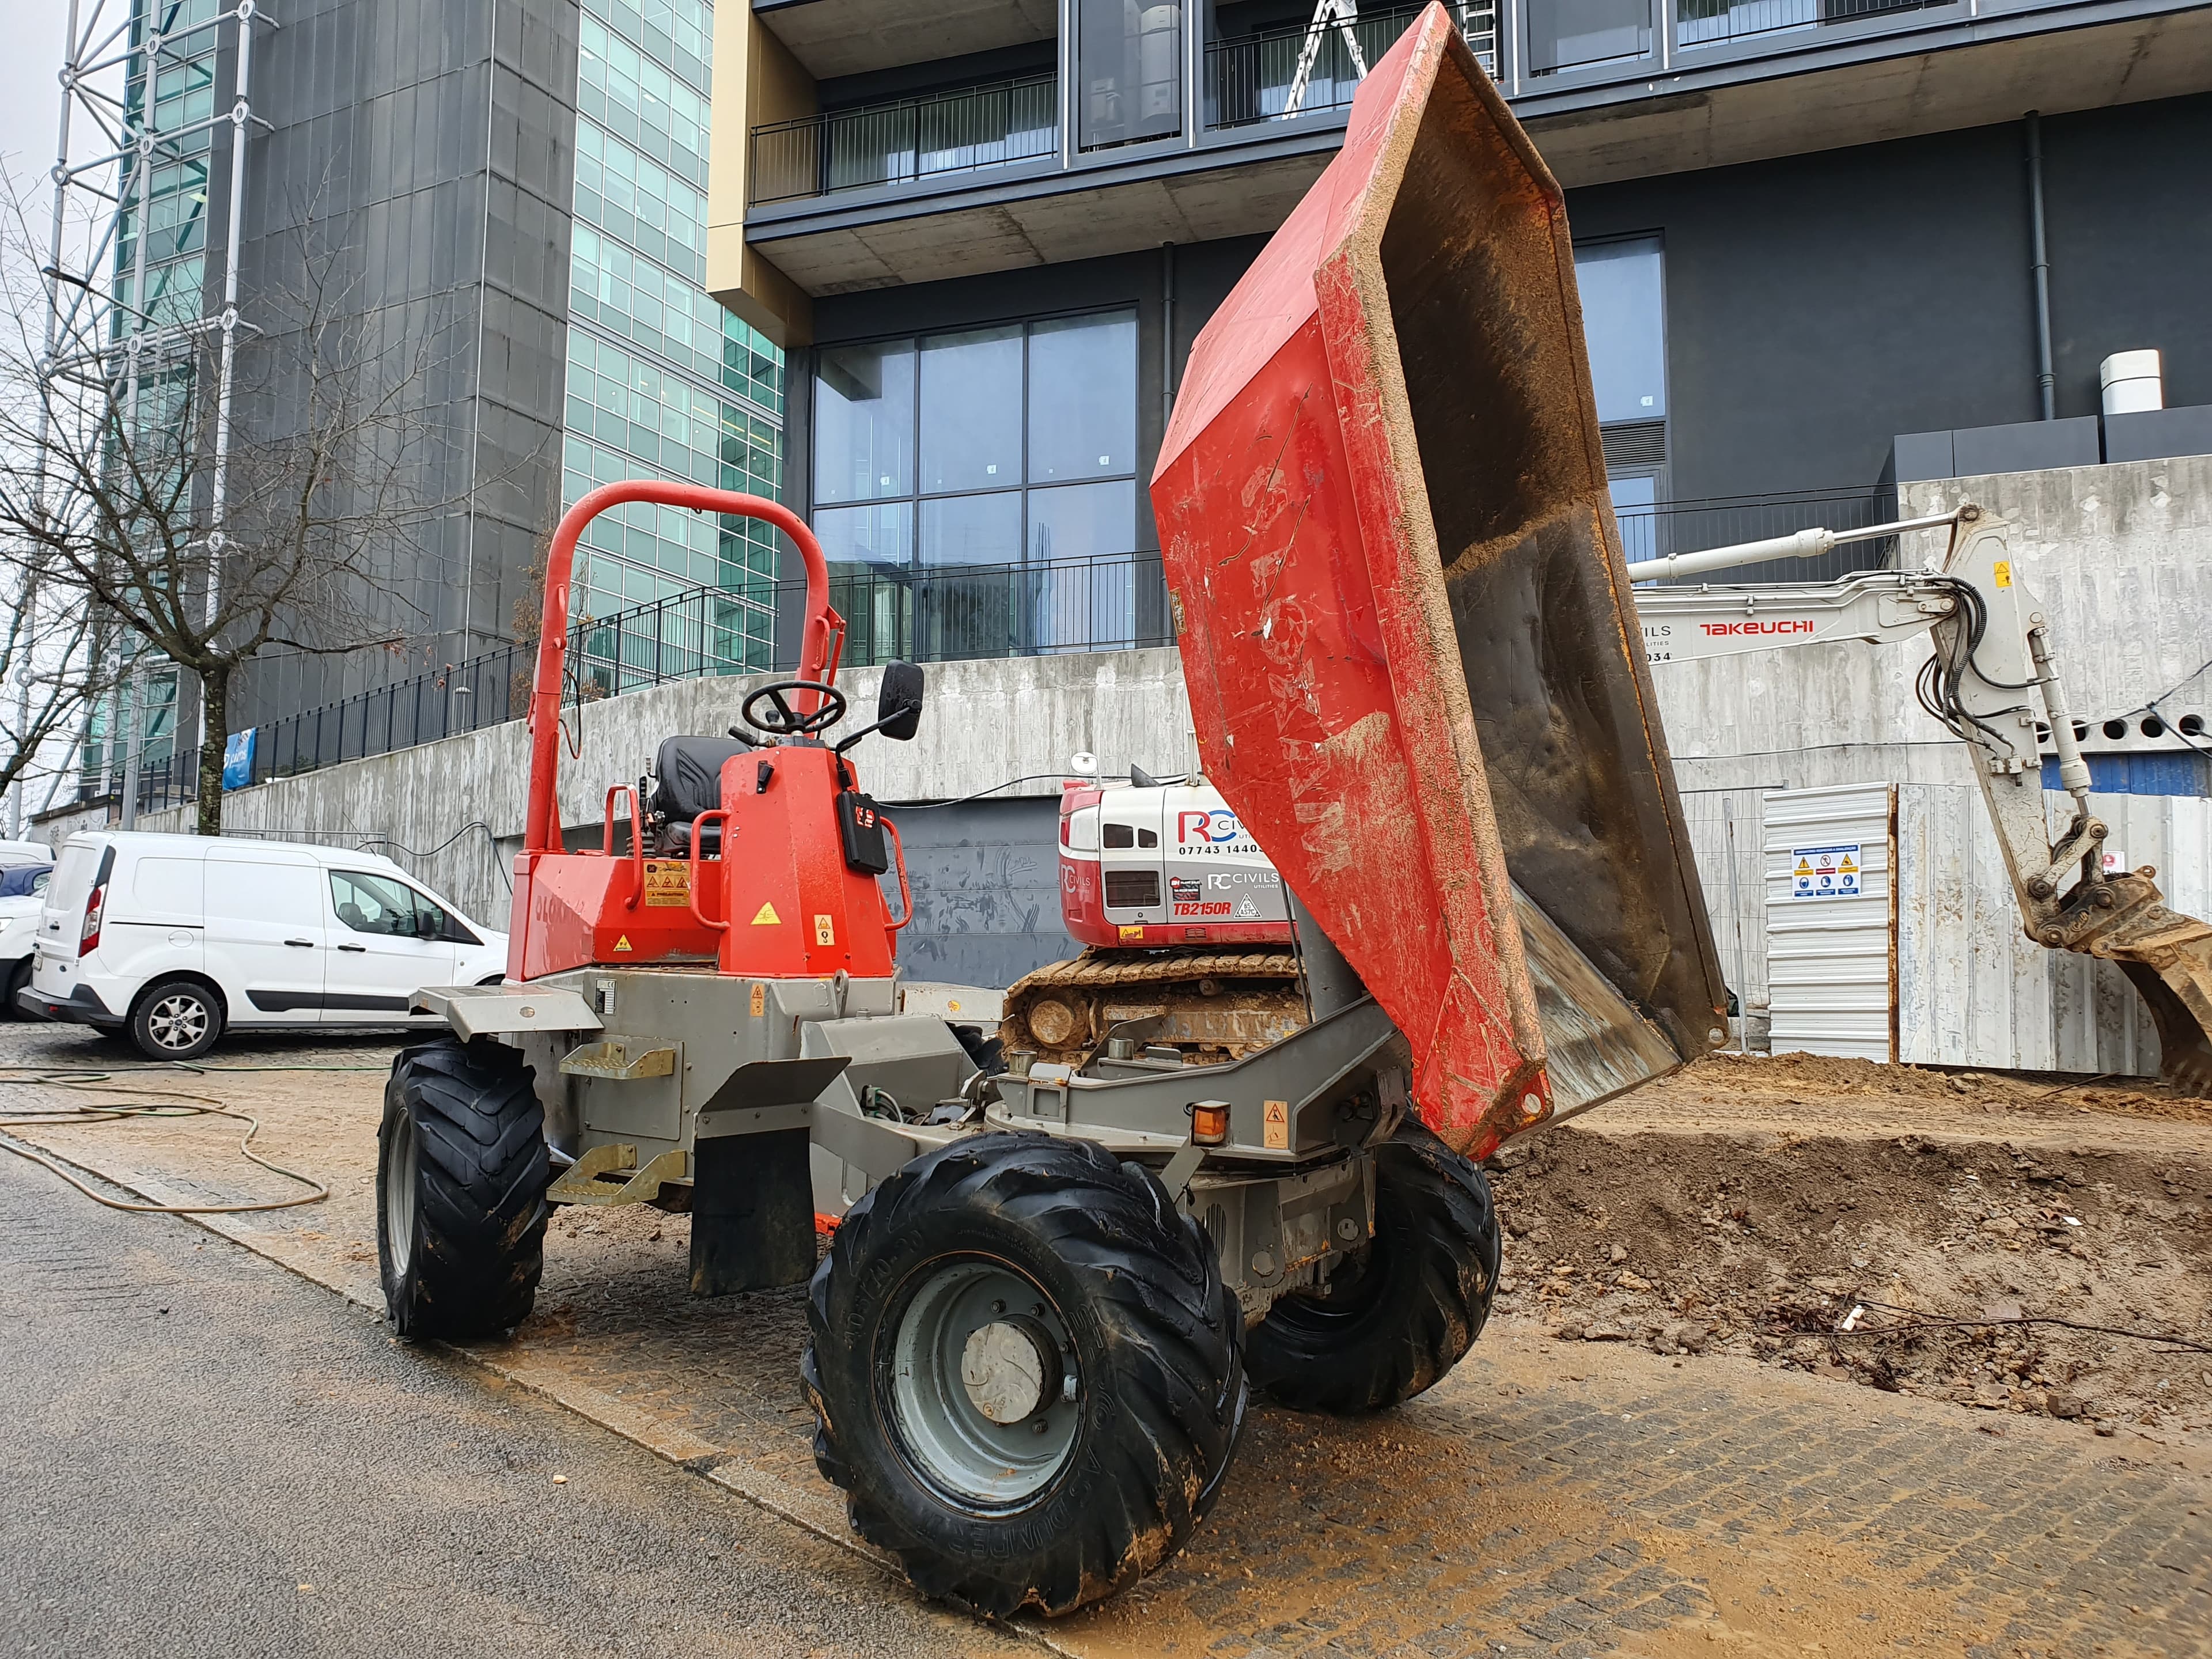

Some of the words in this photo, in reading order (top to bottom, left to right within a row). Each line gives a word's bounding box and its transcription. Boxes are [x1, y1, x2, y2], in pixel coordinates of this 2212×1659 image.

[1641, 626, 1671, 637] ILS
[1700, 620, 1813, 635] TAKEUCHI
[1178, 809, 1237, 843] RC
[1179, 846, 1219, 855] 07743
[1226, 844, 1263, 853] 1440
[1069, 875, 1090, 886] CIVILS
[1207, 873, 1232, 890] RC
[1232, 873, 1279, 884] CIVILS
[1174, 902, 1231, 915] TB2150R
